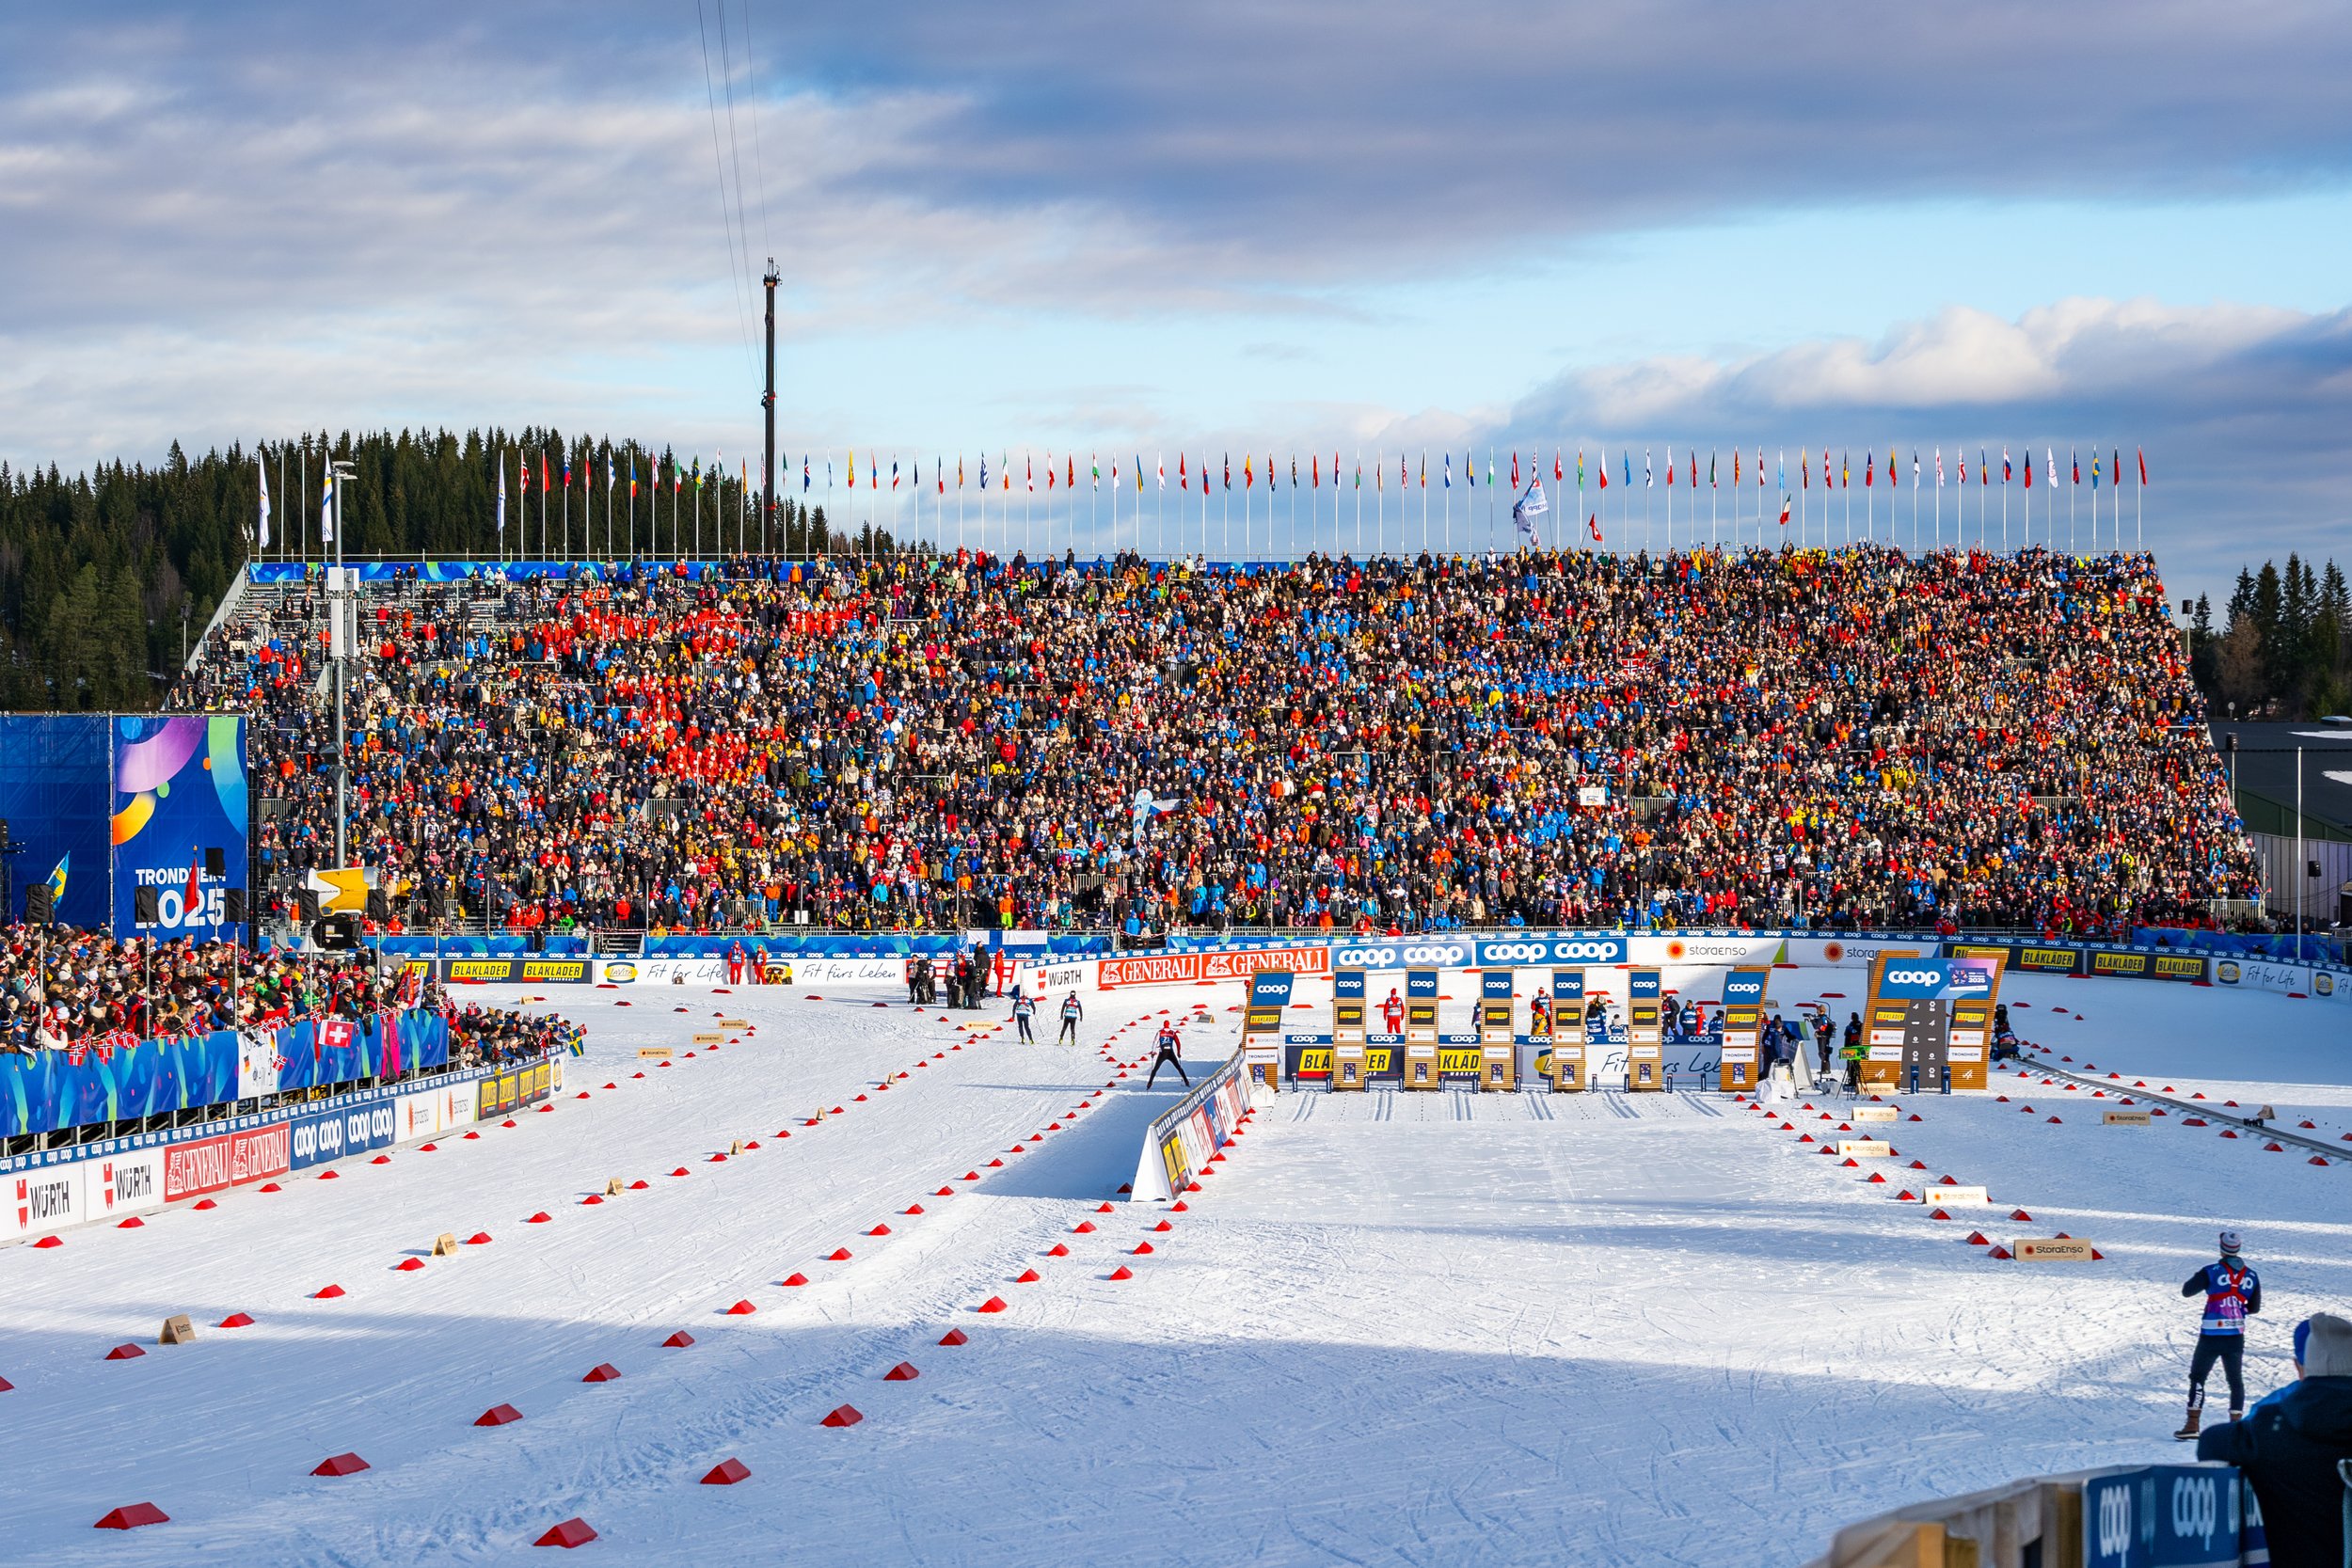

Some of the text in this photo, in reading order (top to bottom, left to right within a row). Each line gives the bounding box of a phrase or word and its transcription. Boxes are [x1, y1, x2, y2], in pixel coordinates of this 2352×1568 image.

[135, 867, 226, 886] TRONDE
[135, 888, 225, 929] 025
[1232, 950, 1323, 974] GENERALI
[1338, 946, 1464, 968] coop coop
[1485, 942, 1618, 963] coop coop
[2024, 950, 2073, 966] BLÅKLÄDER
[453, 963, 508, 975] BLÅKLÄDER
[527, 963, 580, 976] BLÅKLÄDER
[802, 963, 896, 982] Fit fürs Leben
[1122, 958, 1197, 982] GENERALI
[2098, 955, 2143, 971] BLÅKLÄDER
[2158, 958, 2200, 974] BLÅKLÄDER
[647, 964, 723, 982] Fit for Life
[1048, 969, 1082, 986] WÜRTH
[1888, 971, 1940, 987] coop
[2247, 965, 2260, 980] Fit
[2262, 968, 2275, 986] for
[2279, 969, 2296, 989] Life
[1257, 984, 1289, 994] coop
[1338, 980, 1361, 989] coop
[1411, 980, 1434, 989] coop
[1633, 981, 1658, 990] coop
[1727, 984, 1759, 993] coop
[1371, 1035, 1397, 1043] coop
[1451, 1035, 1476, 1043] coop
[1688, 1035, 1714, 1044] coop
[1688, 1052, 1721, 1073] Leb
[348, 1112, 371, 1148] coop
[372, 1107, 393, 1142] coop
[294, 1118, 342, 1161] coop coop
[248, 1129, 288, 1177] GENERALI
[183, 1142, 229, 1192] GENERALI
[115, 1164, 151, 1200] WÜRTH
[30, 1181, 70, 1219] WÜRTH
[2099, 1483, 2132, 1568] coop
[2172, 1477, 2217, 1551] coop
